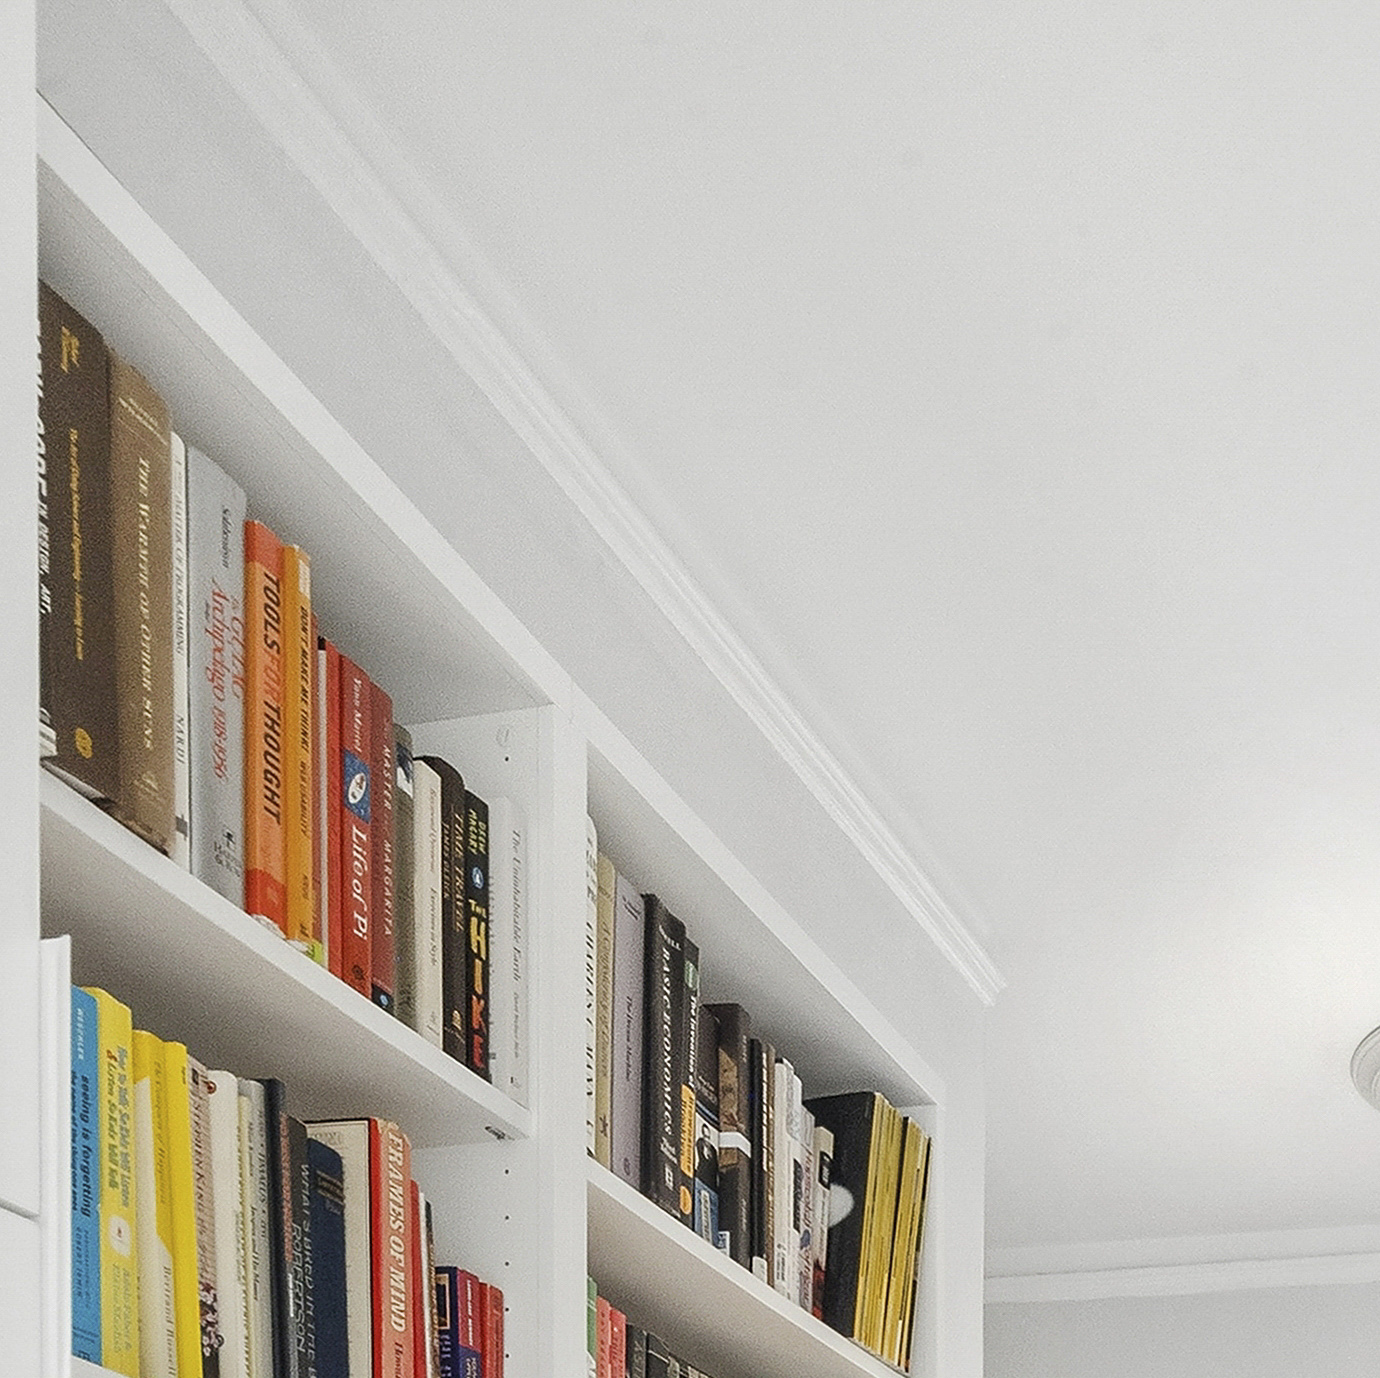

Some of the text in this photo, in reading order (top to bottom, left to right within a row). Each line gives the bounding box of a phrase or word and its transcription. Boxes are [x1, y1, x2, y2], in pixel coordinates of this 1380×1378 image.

[138, 458, 153, 750] THE WARMTH OF OTHER SUNS
[175, 562, 184, 656] PROGRAMMING
[205, 577, 230, 702] Archipelago
[176, 715, 185, 764] NARDI
[264, 571, 281, 825] TOOLS FOR THOUGHT
[300, 605, 309, 838] DON'T MAKE ME THINK! USABILITY
[353, 676, 362, 753] Yann Martel
[352, 824, 368, 940] Life of Pi
[382, 744, 392, 936] MASTER MARGARITA
[442, 821, 450, 858] JAMES
[454, 812, 464, 933] TIME TRAVEL
[468, 808, 478, 856] MAGARY
[478, 821, 486, 856] DREW
[512, 830, 521, 982] The Uninhabitable Earth
[470, 916, 486, 1069] HIKE
[662, 948, 672, 1136] BASIC ECONOMICS
[687, 994, 698, 1078] The Invention
[106, 1062, 118, 1096] Listen
[80, 1075, 93, 1218] seeing is forgetting
[192, 1101, 205, 1214] STEPHEN KING
[388, 1131, 405, 1231] FRAMES
[802, 1149, 812, 1228] Hopscotch
[292, 1223, 305, 1353] ROBERTSON
[303, 1236, 314, 1289] BRED
[389, 1235, 404, 1264] OF
[162, 1265, 176, 1378] Bertrand Russell
[305, 1294, 315, 1314] IN
[305, 1320, 316, 1361] THE
[390, 1269, 405, 1334] MIND
